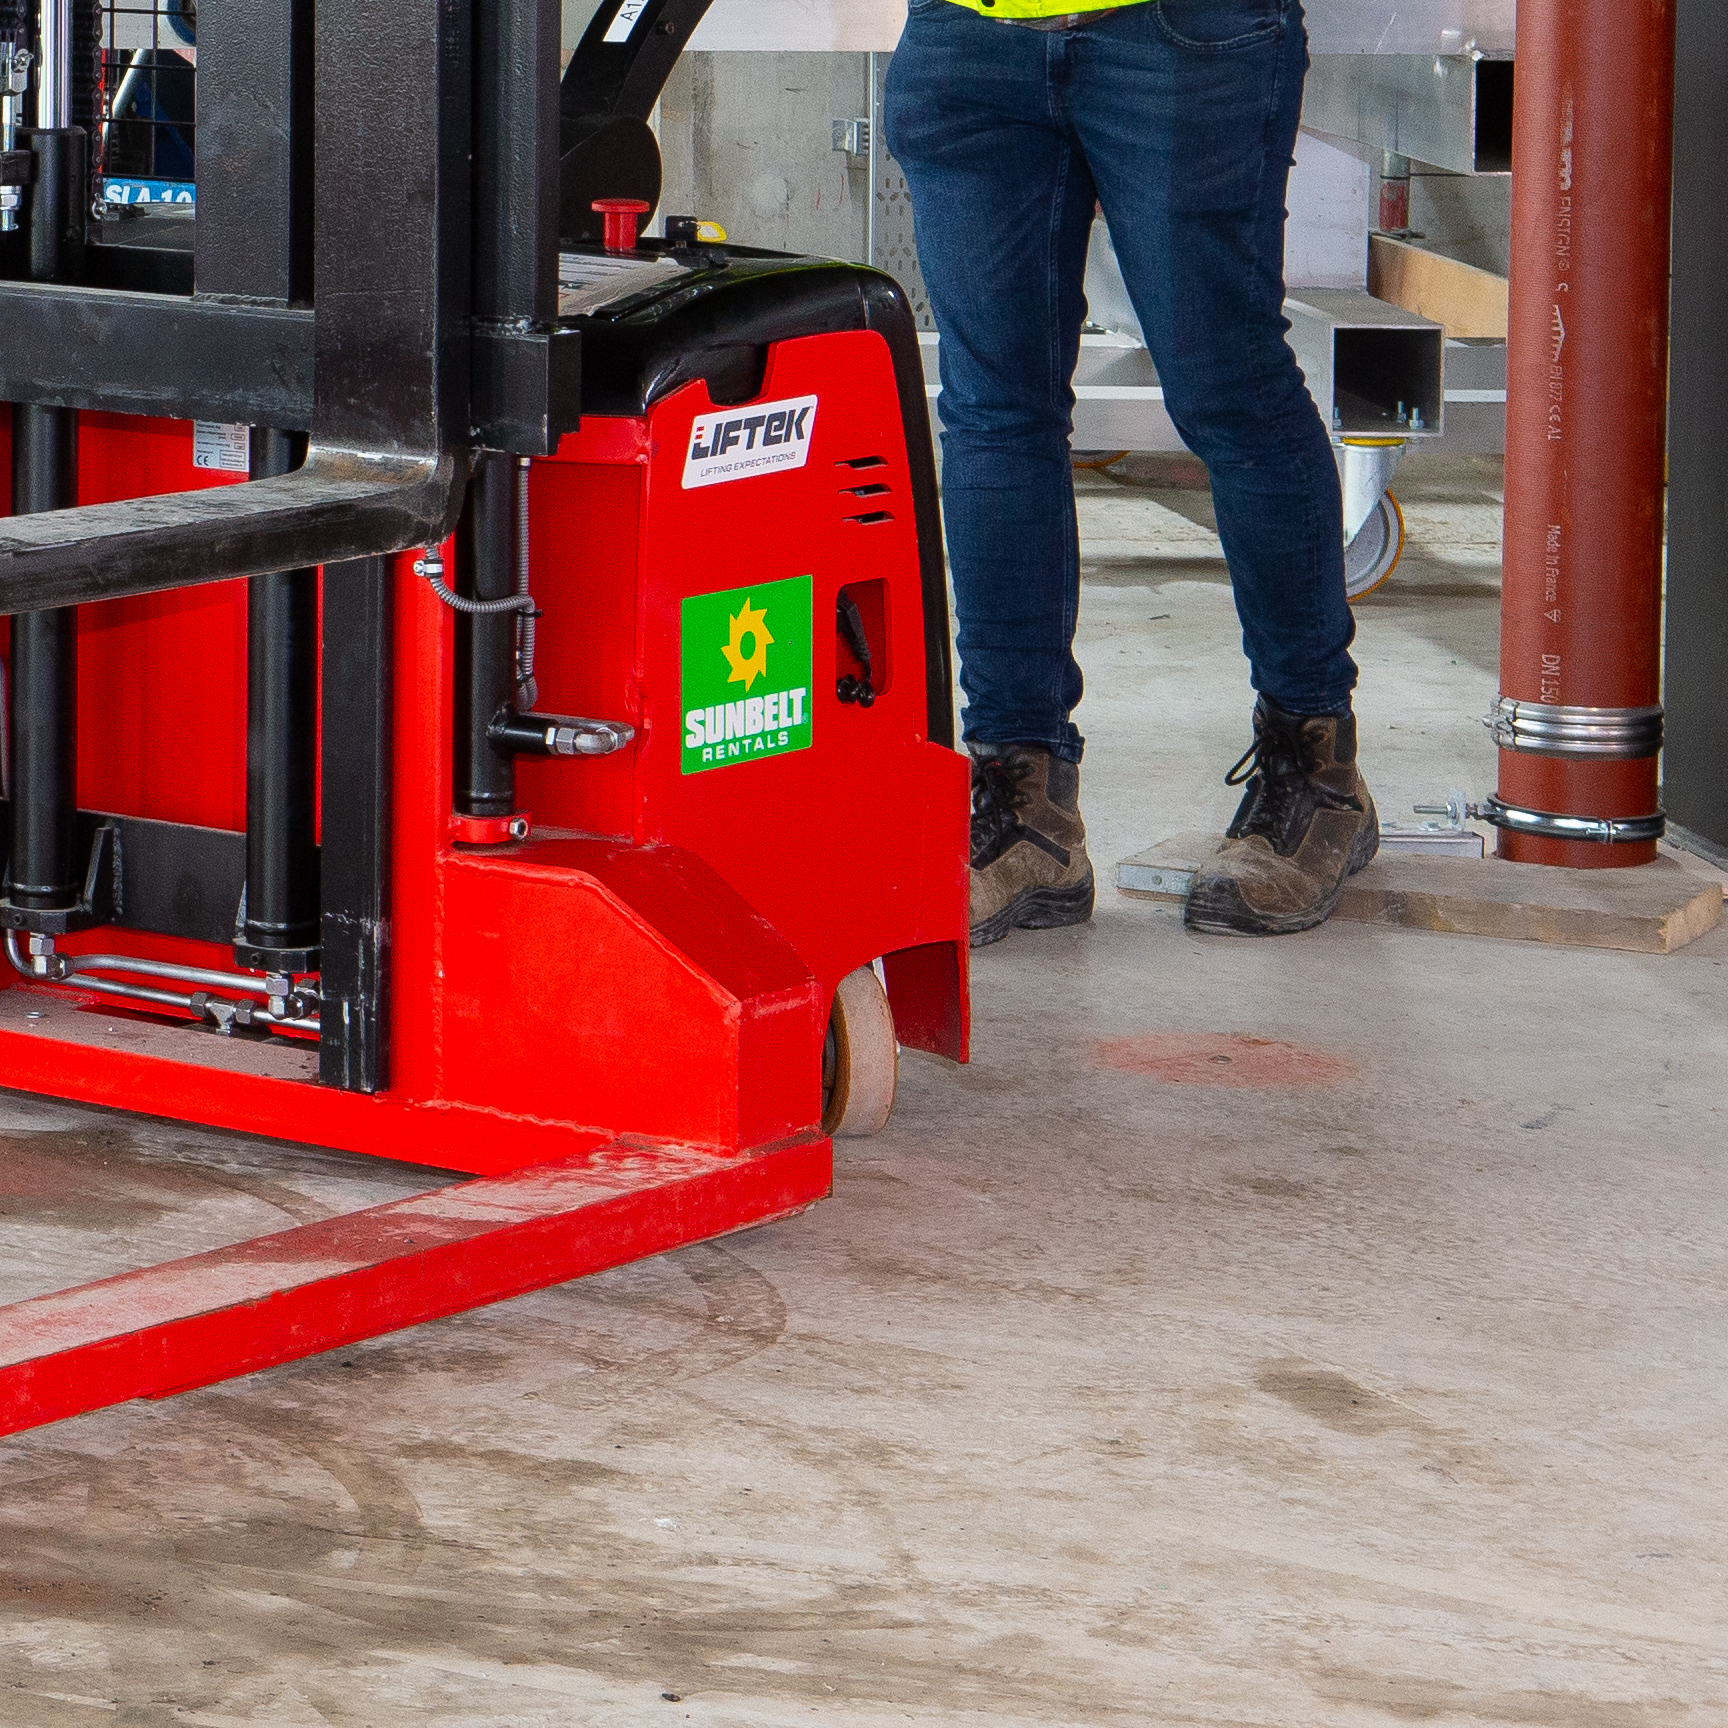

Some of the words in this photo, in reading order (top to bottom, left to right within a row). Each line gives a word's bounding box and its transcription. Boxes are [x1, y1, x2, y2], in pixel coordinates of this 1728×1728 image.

[1556, 196, 1572, 256] ENSIGN
[700, 464, 732, 477] LIFTING
[734, 452, 796, 471] EXPECTATIONS
[1546, 524, 1562, 552] Made
[1546, 555, 1560, 565] in
[1546, 567, 1560, 602] France
[1541, 654, 1560, 676] DN
[1540, 678, 1559, 702] 150
[685, 687, 806, 748] SUNBELT
[702, 731, 789, 762] RENTALS
